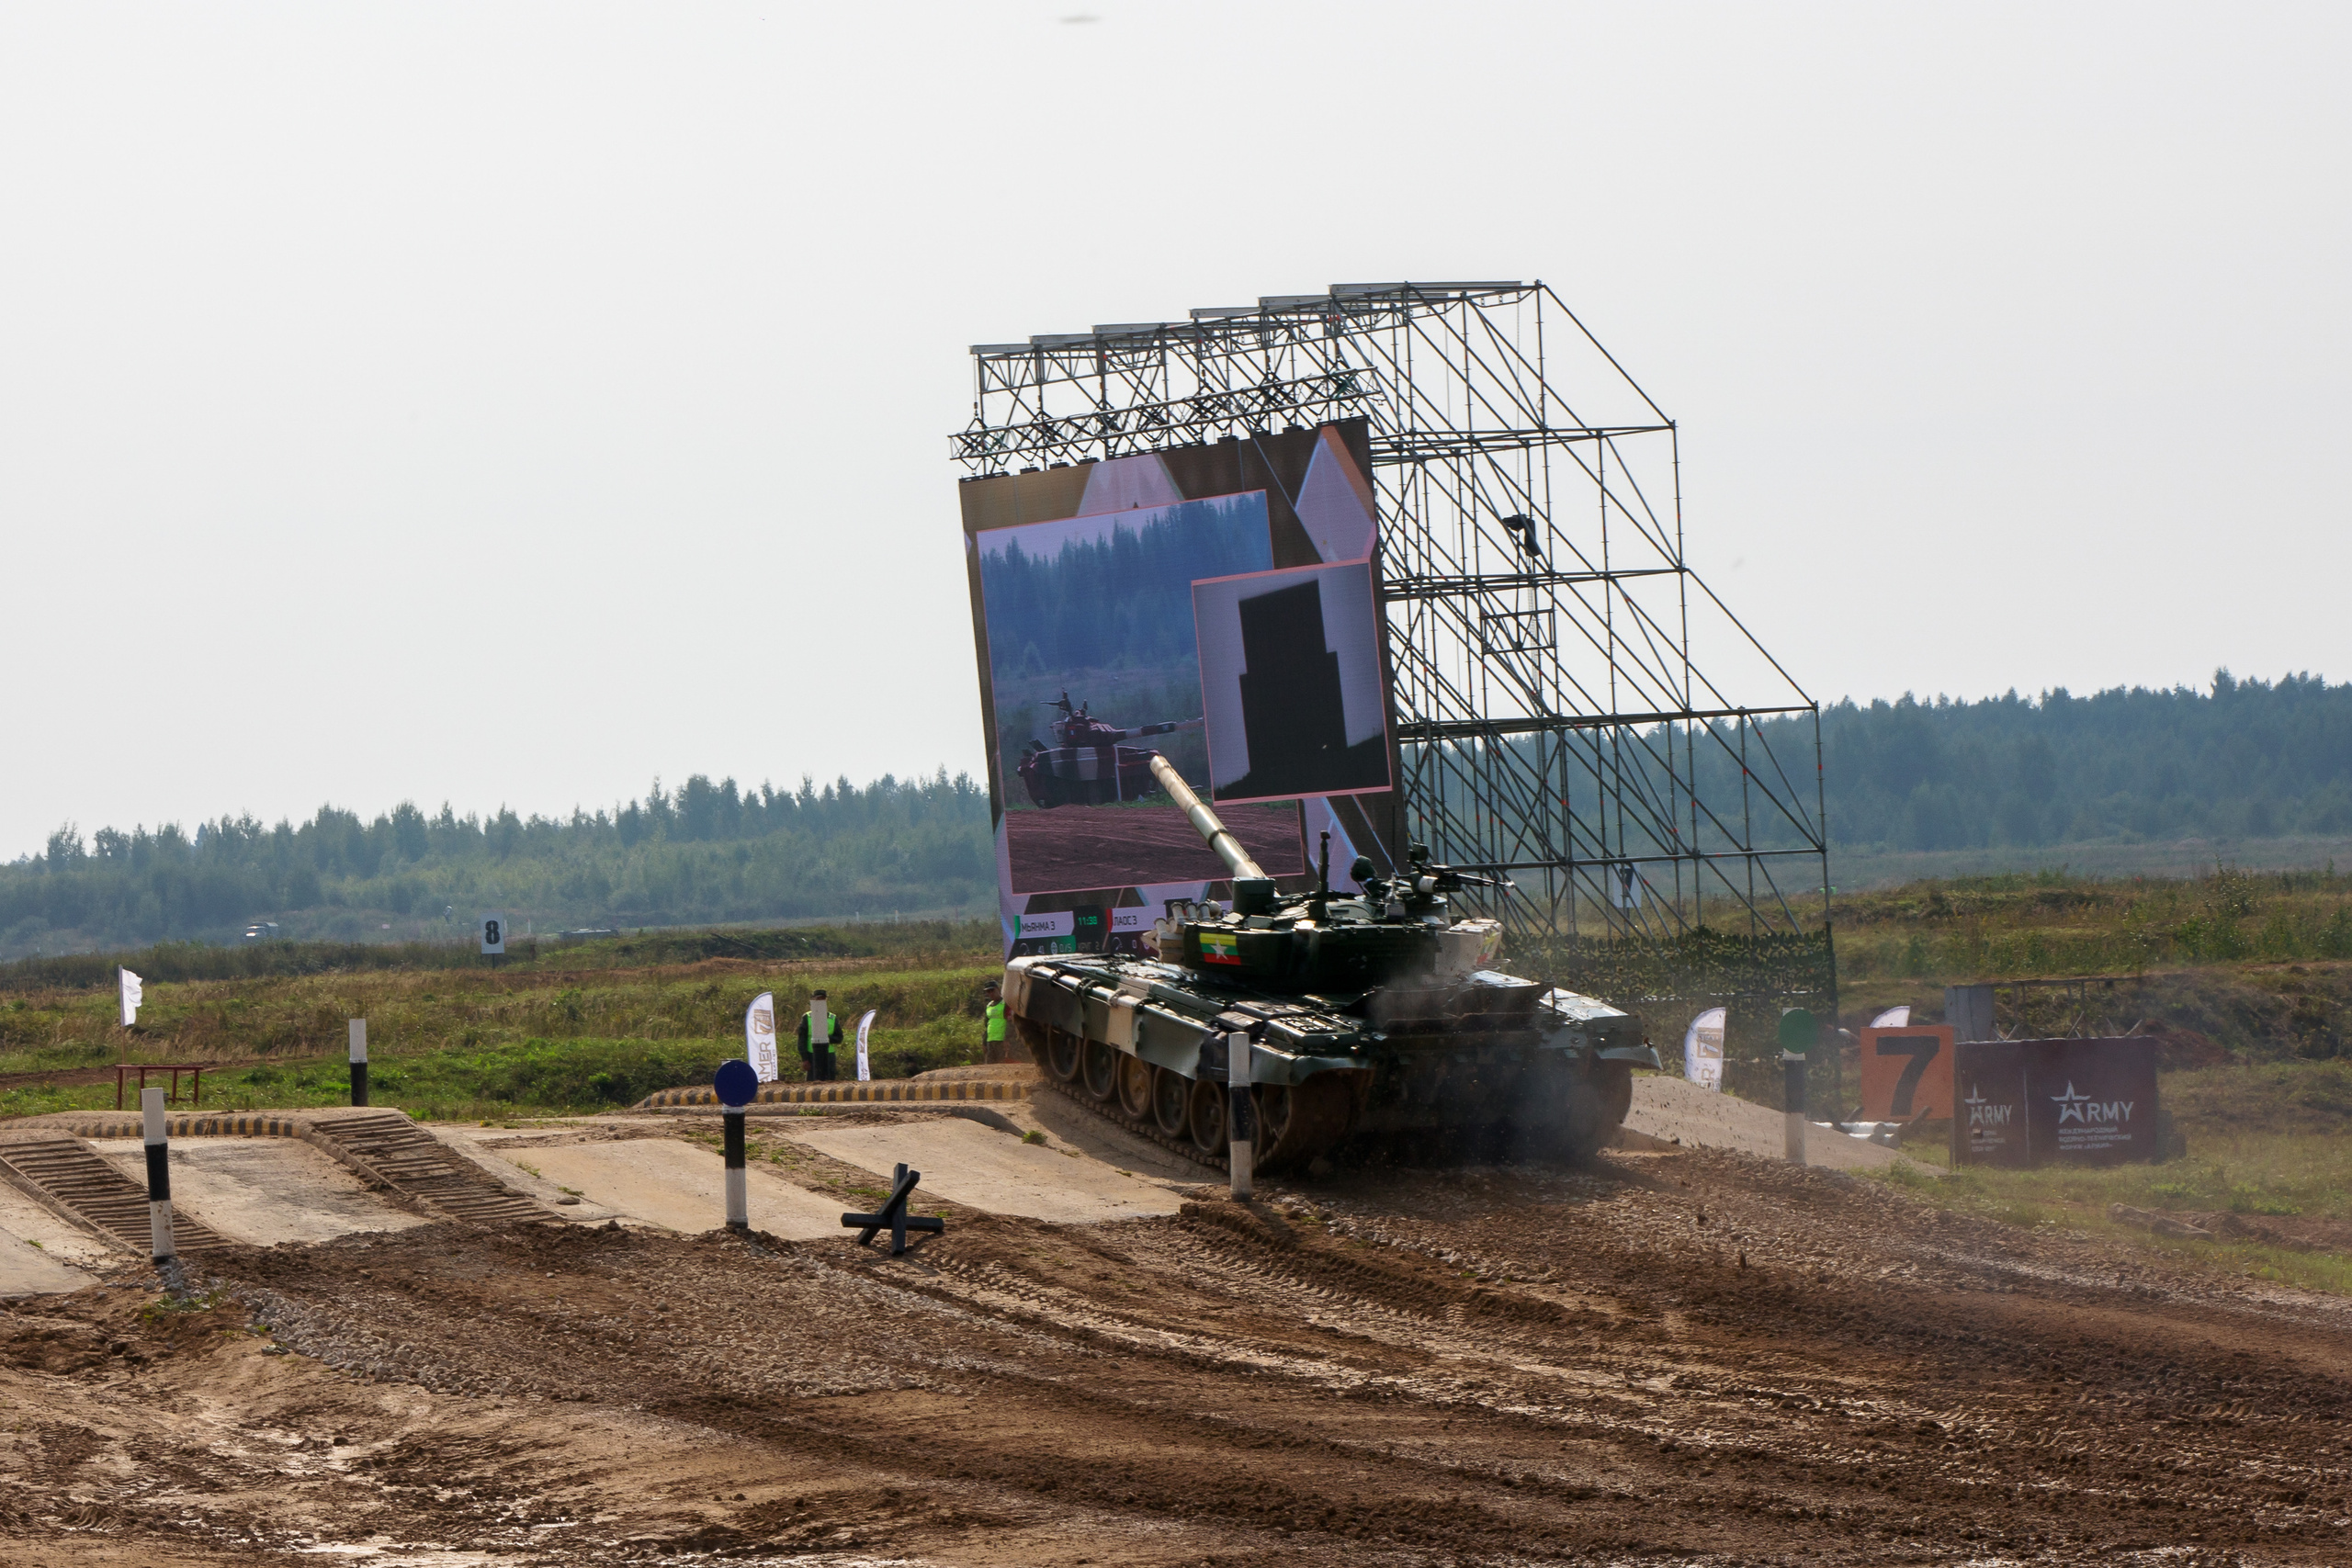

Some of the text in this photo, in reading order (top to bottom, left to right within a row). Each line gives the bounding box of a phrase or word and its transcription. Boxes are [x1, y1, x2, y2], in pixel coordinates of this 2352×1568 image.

[485, 919, 501, 945] 8
[1022, 921, 1056, 932] МЬЯНМА 3
[1114, 916, 1137, 926] ЛАОС 3
[1095, 941, 1100, 951] 2
[1876, 1035, 1940, 1116] 7
[1964, 1085, 2012, 1126] ARMY
[2050, 1079, 2134, 1124] ARMY
